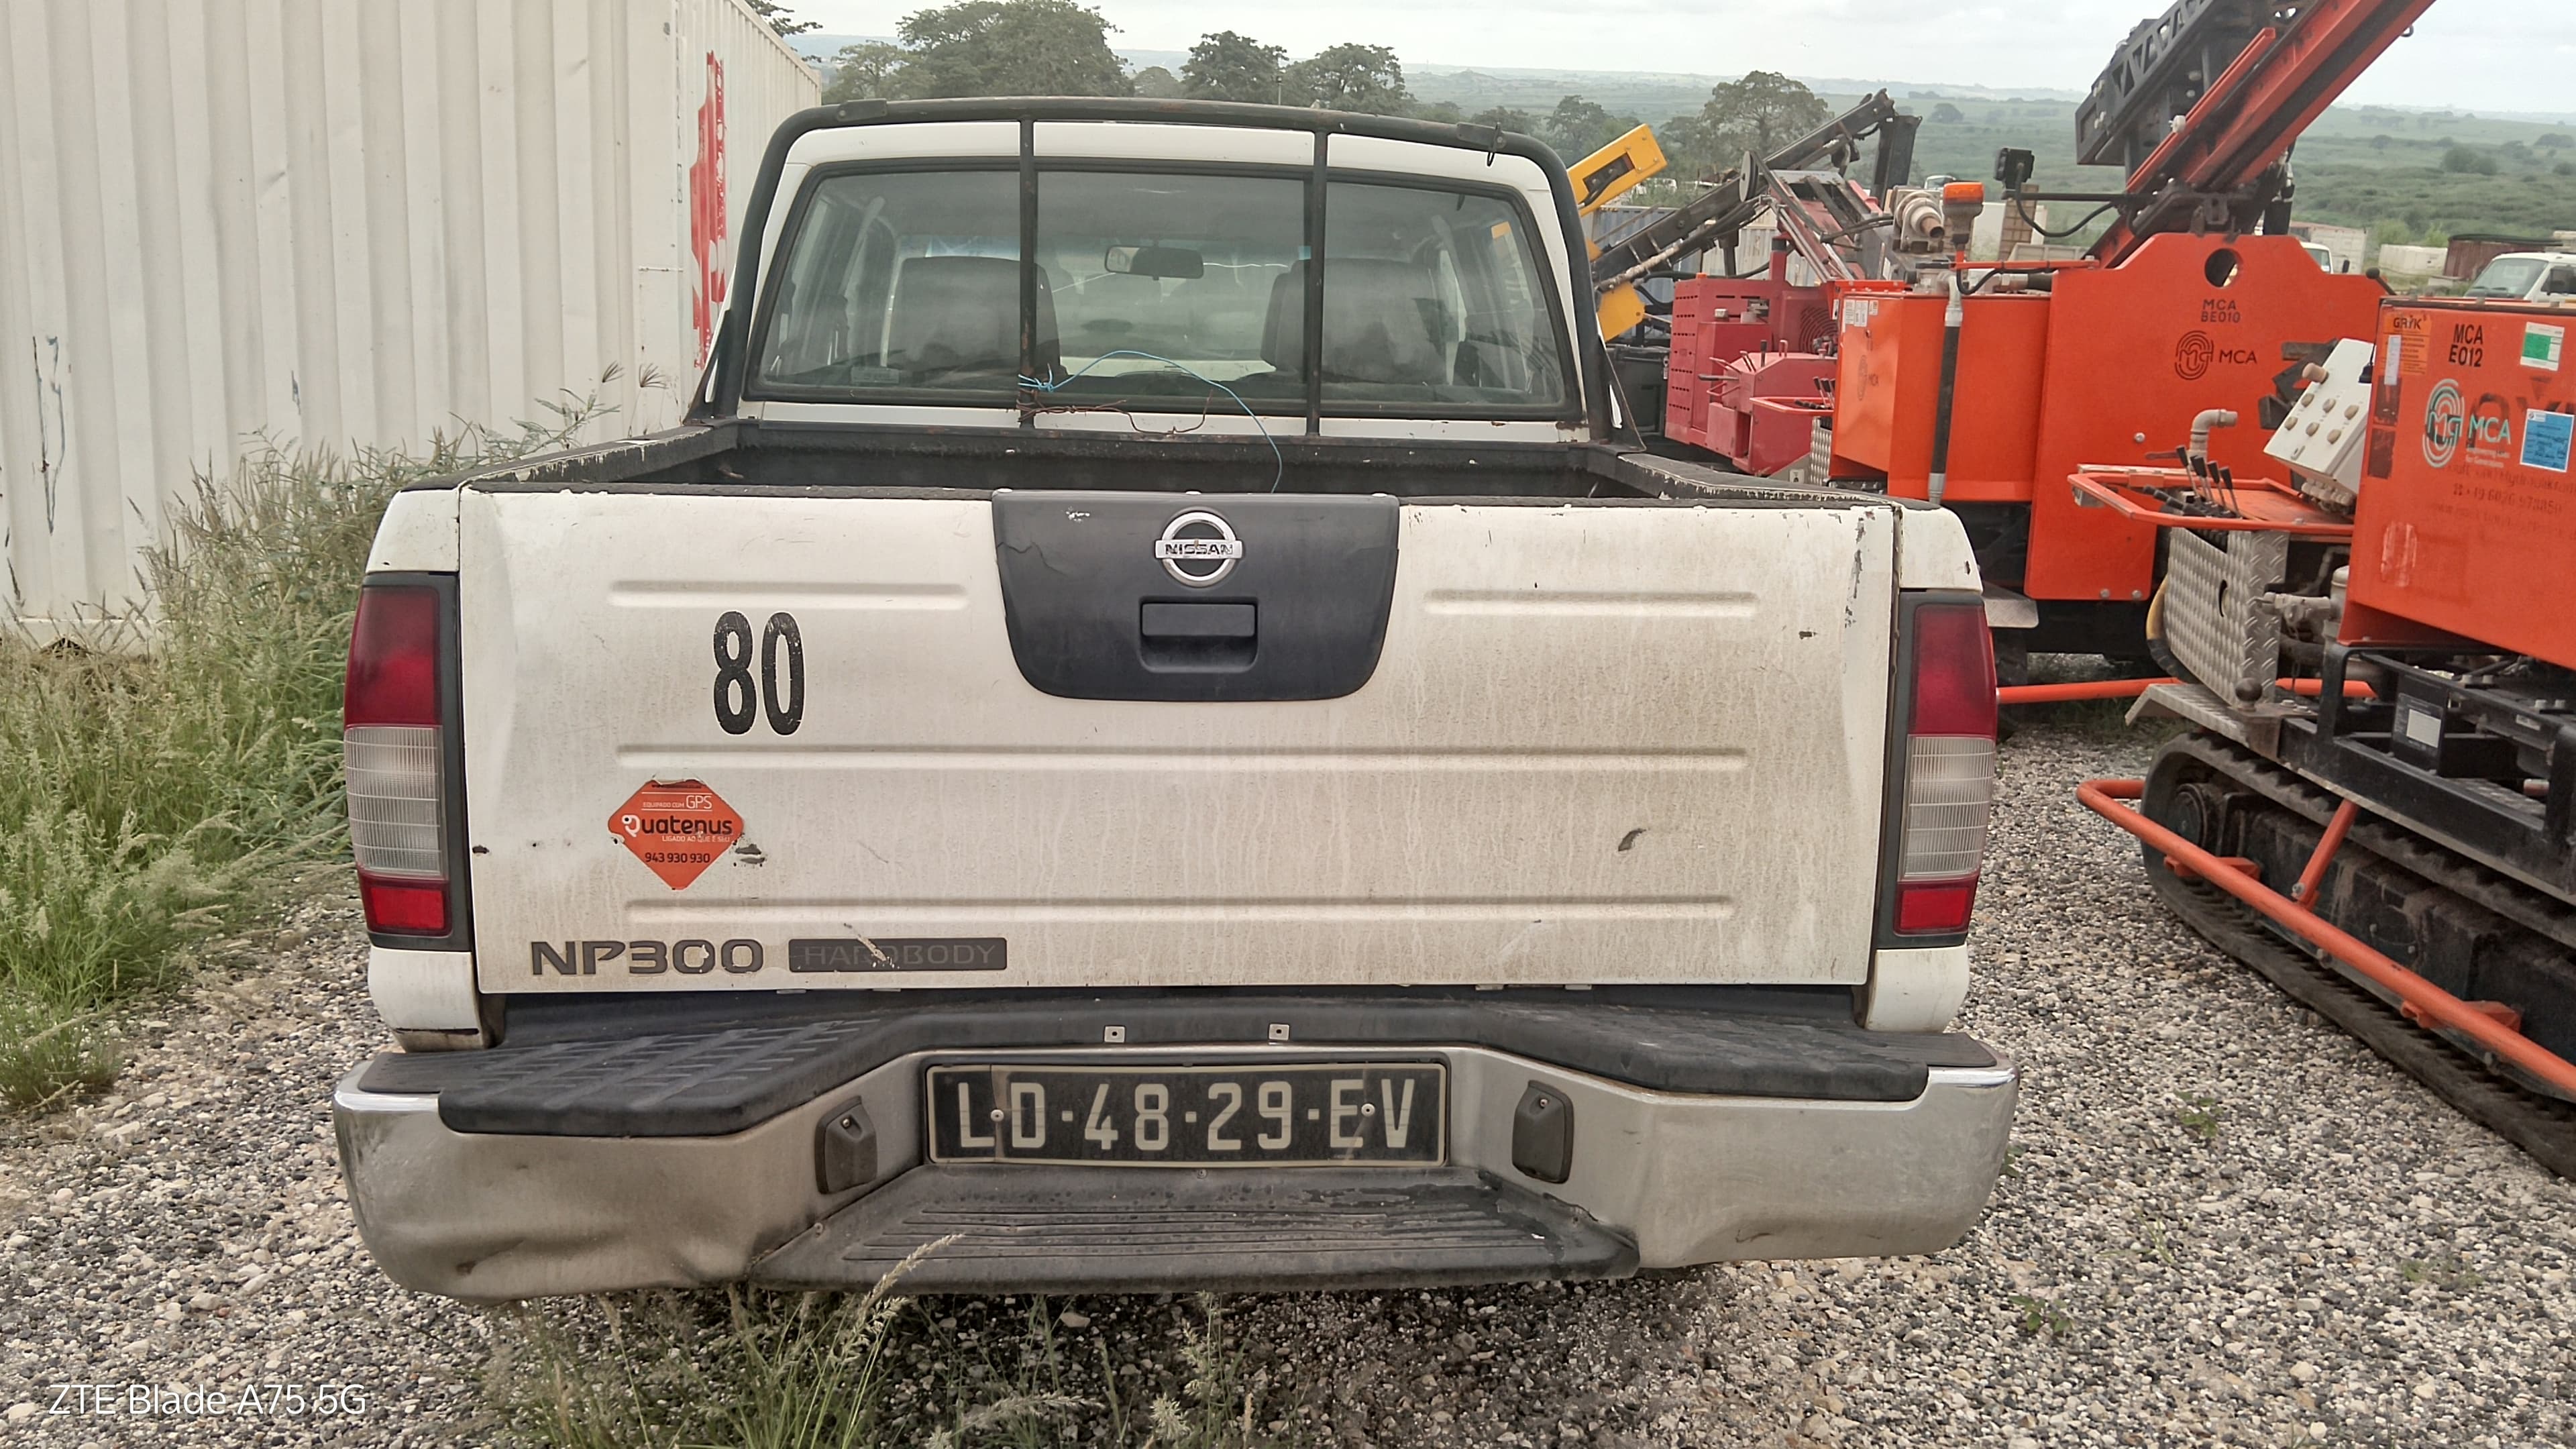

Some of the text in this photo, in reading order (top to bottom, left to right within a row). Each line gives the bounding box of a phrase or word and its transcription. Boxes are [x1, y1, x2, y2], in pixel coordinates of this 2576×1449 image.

[2203, 299, 2237, 310] MCA
[2453, 323, 2483, 344] MCA
[2219, 350, 2257, 364] MCA
[2449, 344, 2483, 368] E012
[2469, 414, 2511, 445] MCA
[1165, 543, 1234, 555] NISSAN
[714, 611, 804, 735] 80
[686, 795, 712, 809] GPS
[645, 852, 710, 863] 943 930 930
[531, 939, 996, 975] NP300 HARDBODY
